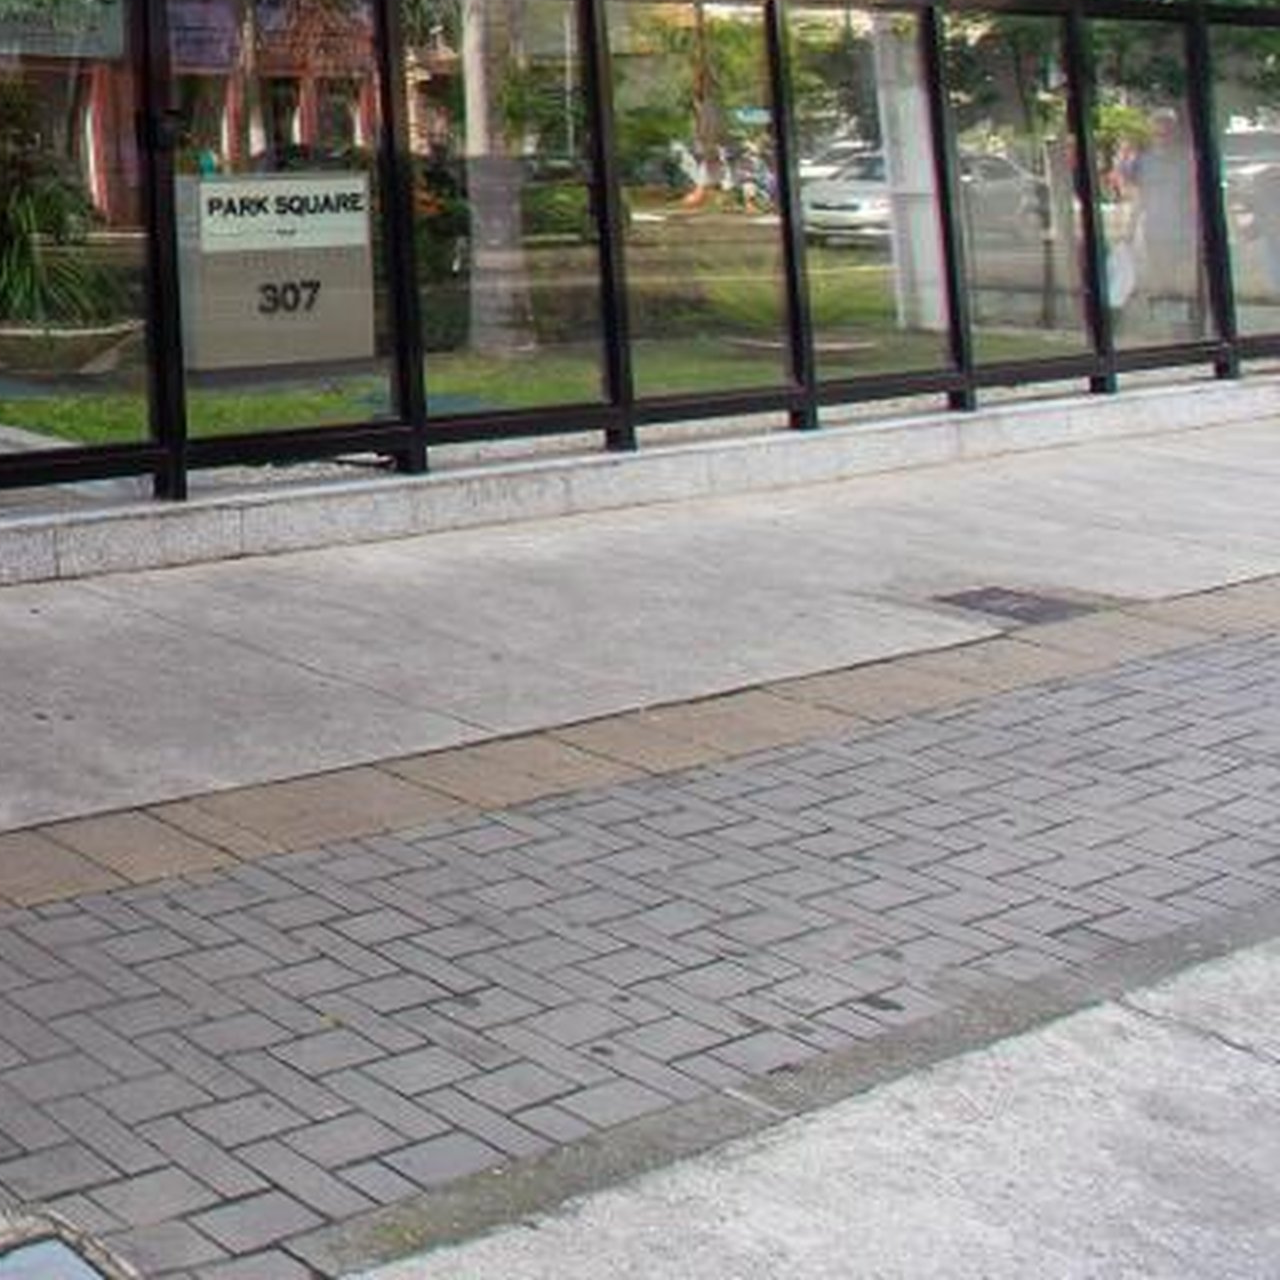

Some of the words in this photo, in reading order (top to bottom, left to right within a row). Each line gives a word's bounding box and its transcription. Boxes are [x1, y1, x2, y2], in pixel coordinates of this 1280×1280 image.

[207, 196, 269, 217] PARK
[275, 192, 364, 217] SQUARE
[258, 280, 321, 314] 307
